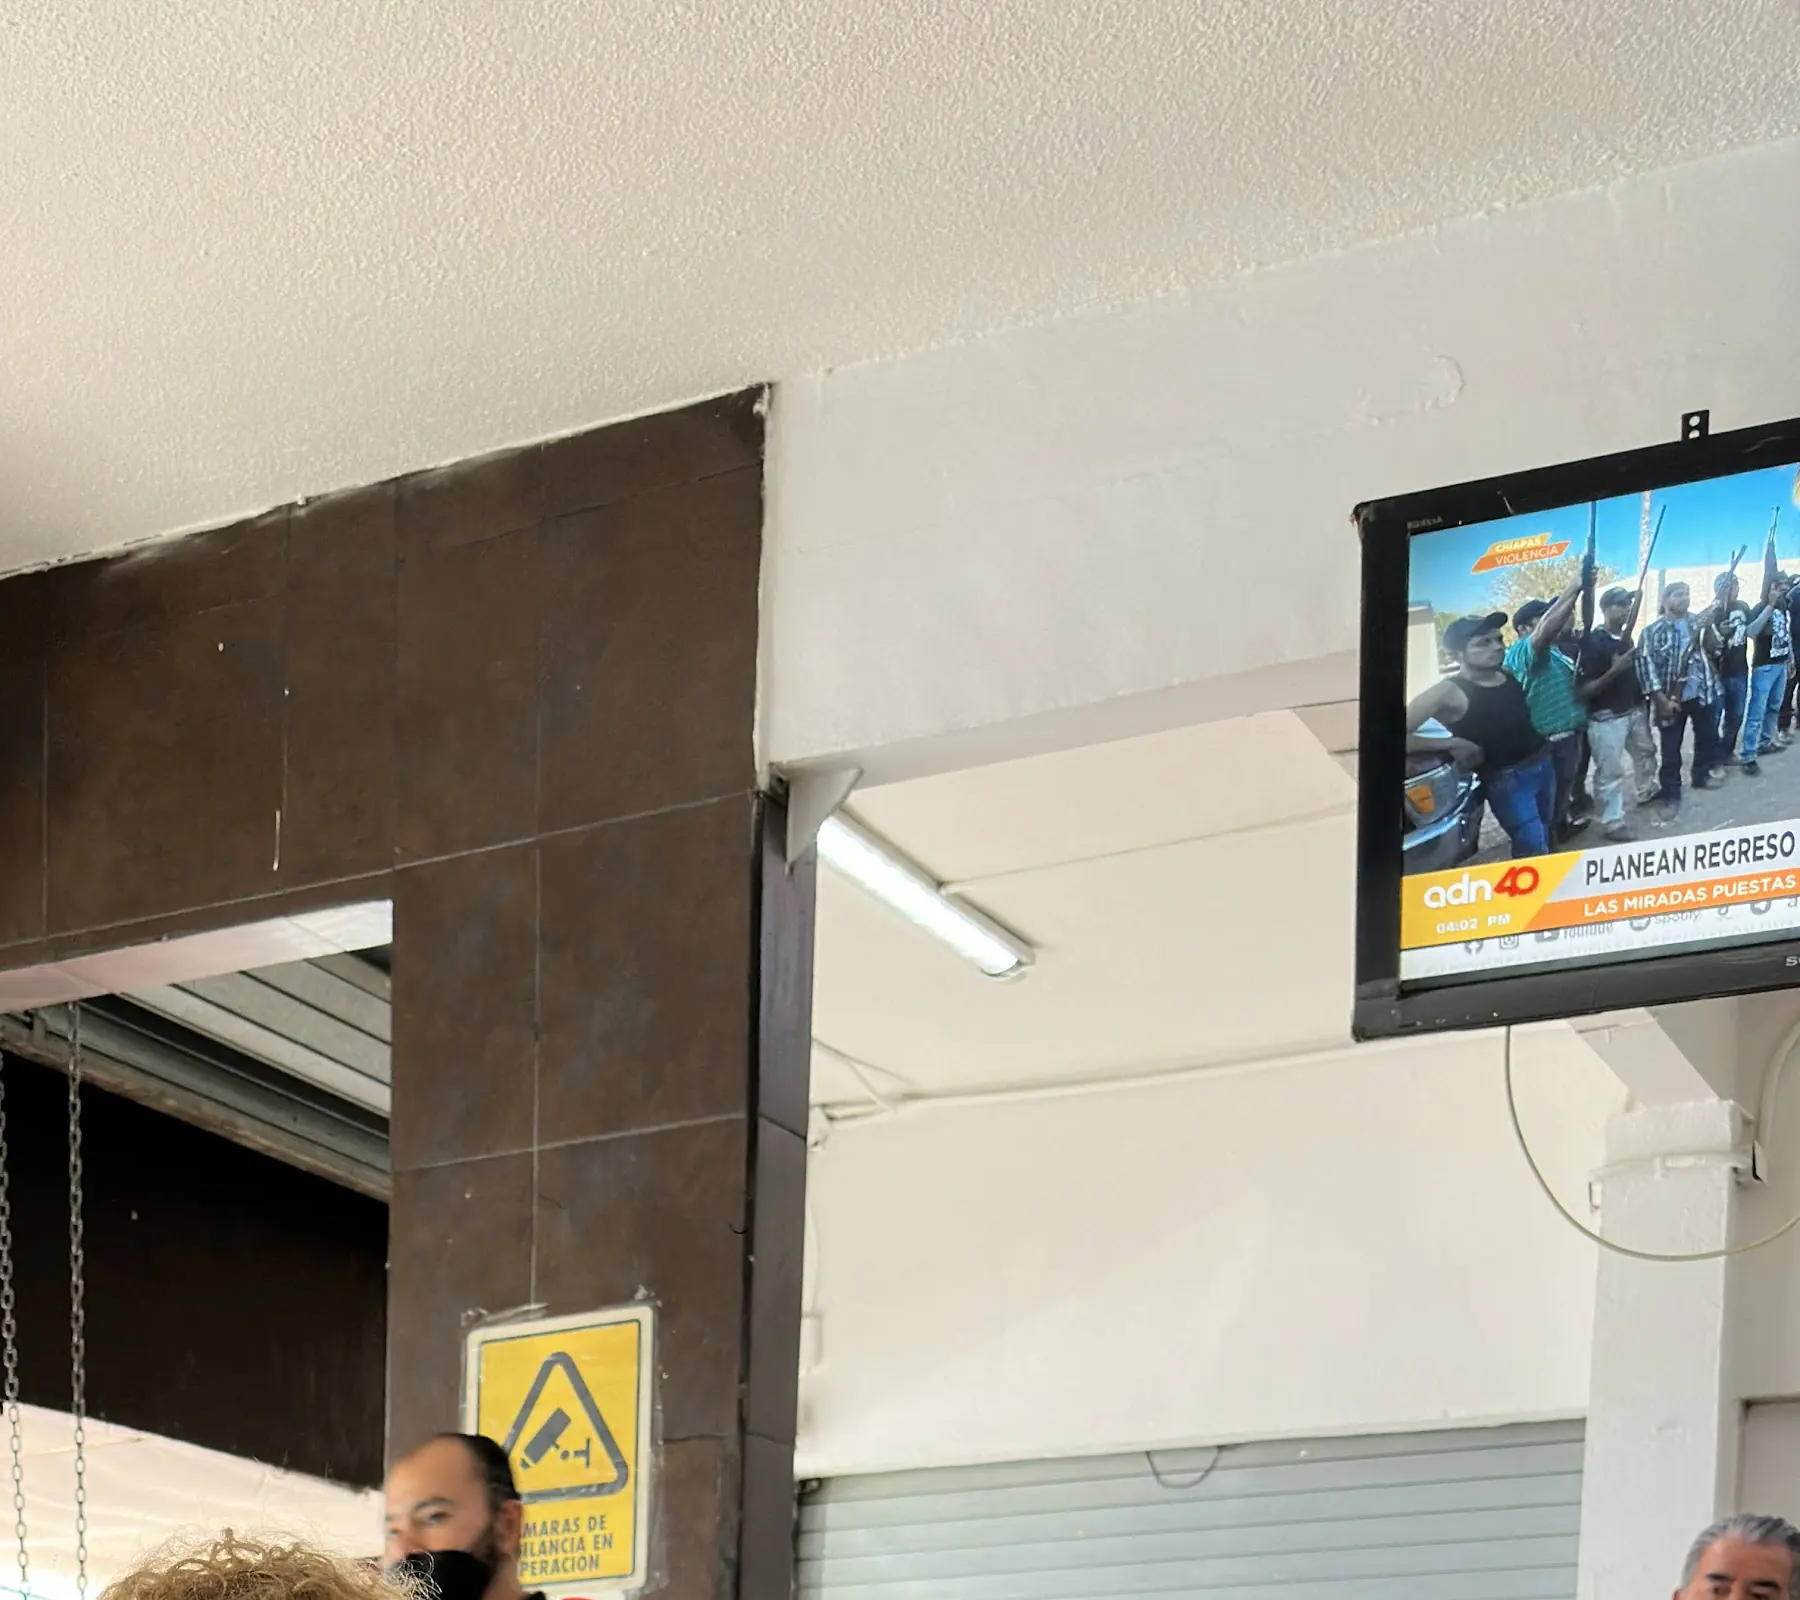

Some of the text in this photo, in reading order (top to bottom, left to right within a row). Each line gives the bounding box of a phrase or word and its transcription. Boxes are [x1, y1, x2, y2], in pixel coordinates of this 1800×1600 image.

[1495, 537, 1541, 553] CHIAPAS
[1495, 545, 1559, 565] VIOLENCIA
[1585, 830, 1796, 886] PLANEAN REGRESO
[1423, 865, 1540, 909] adn40
[1583, 874, 1797, 917] LAS MIRADAS PUESTAS
[1487, 914, 1512, 929] PM
[522, 1514, 607, 1538] MARAS DE
[521, 1533, 613, 1558] ILANCIA EN
[520, 1555, 599, 1577] PERACION
